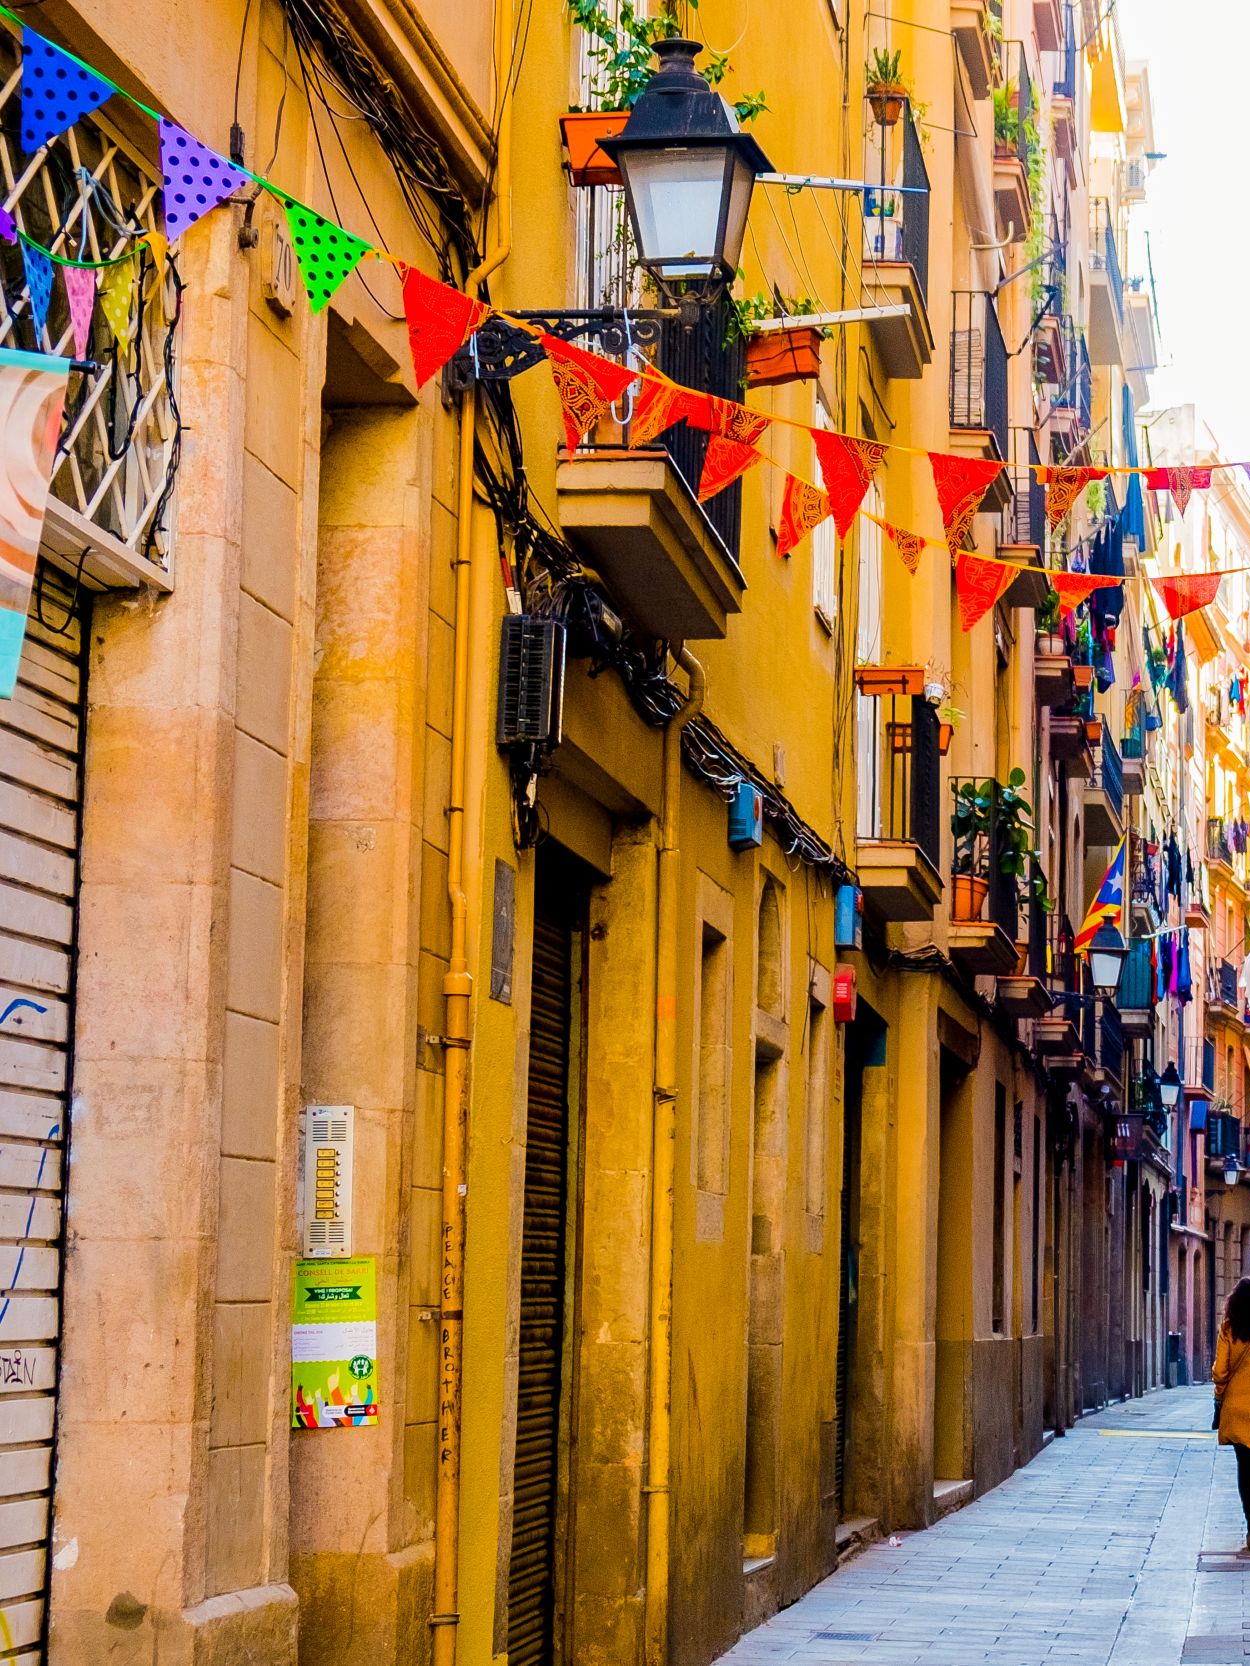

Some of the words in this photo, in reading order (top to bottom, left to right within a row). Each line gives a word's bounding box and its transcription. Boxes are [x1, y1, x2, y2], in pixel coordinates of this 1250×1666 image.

[276, 233, 292, 291] 70
[297, 1268, 333, 1277] CONSELL
[335, 1267, 346, 1275] DE
[347, 1266, 369, 1275] BARRI
[443, 1225, 456, 1300] PEACE
[441, 1329, 455, 1464] BROTHER
